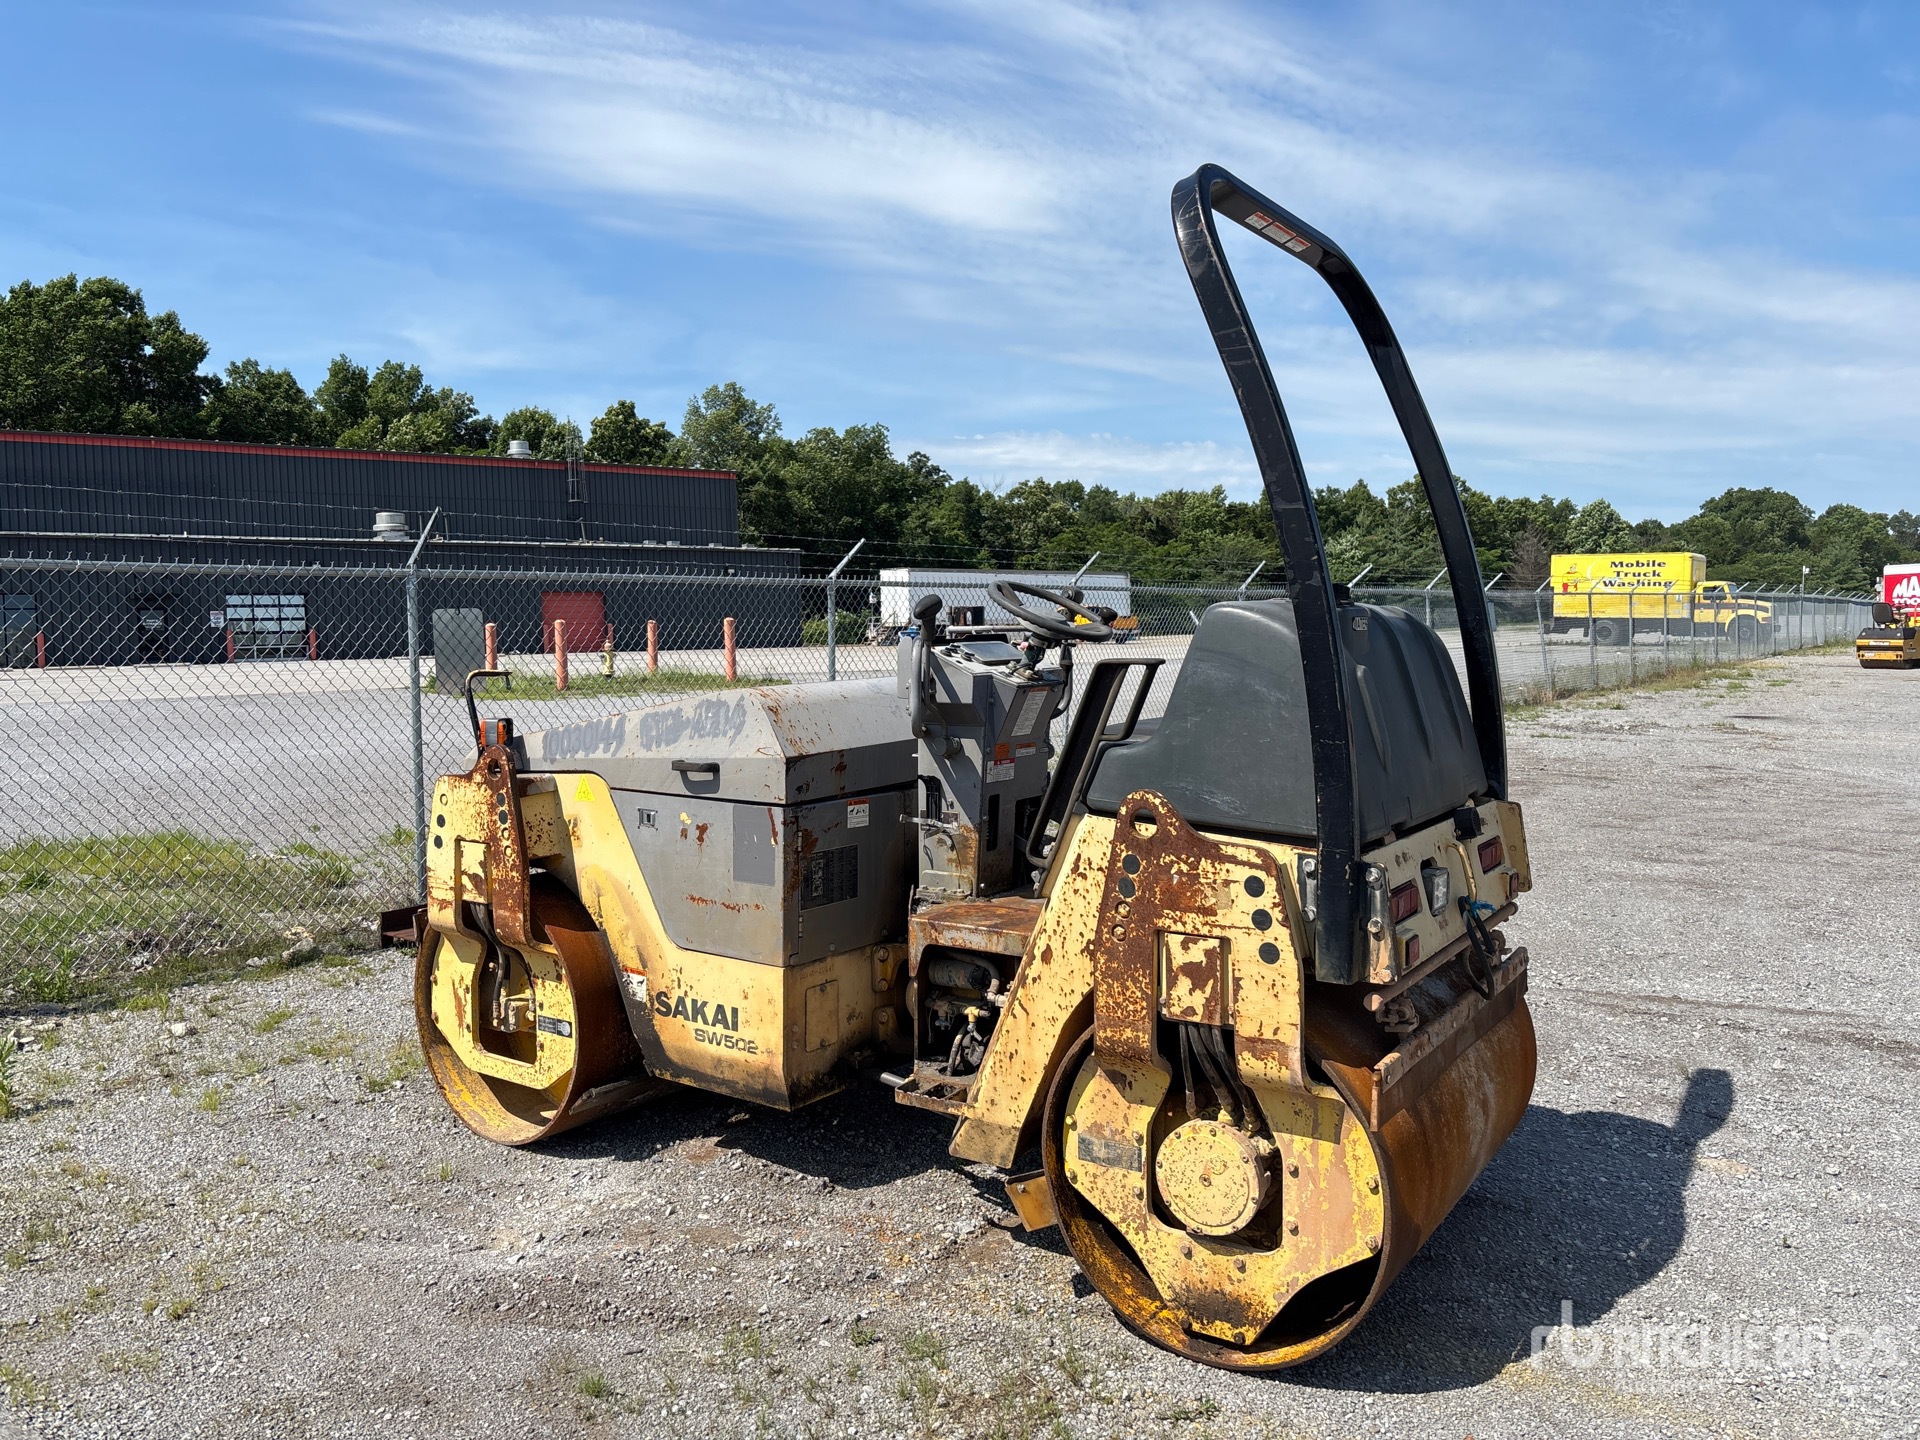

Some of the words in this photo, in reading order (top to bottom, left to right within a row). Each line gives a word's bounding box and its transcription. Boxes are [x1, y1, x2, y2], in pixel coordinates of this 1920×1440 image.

[1610, 560, 1667, 568] Mobile
[1613, 570, 1662, 578] Truck
[1602, 580, 1673, 589] Washing
[654, 991, 739, 1032] SAKAI
[694, 1028, 759, 1055] SW502
